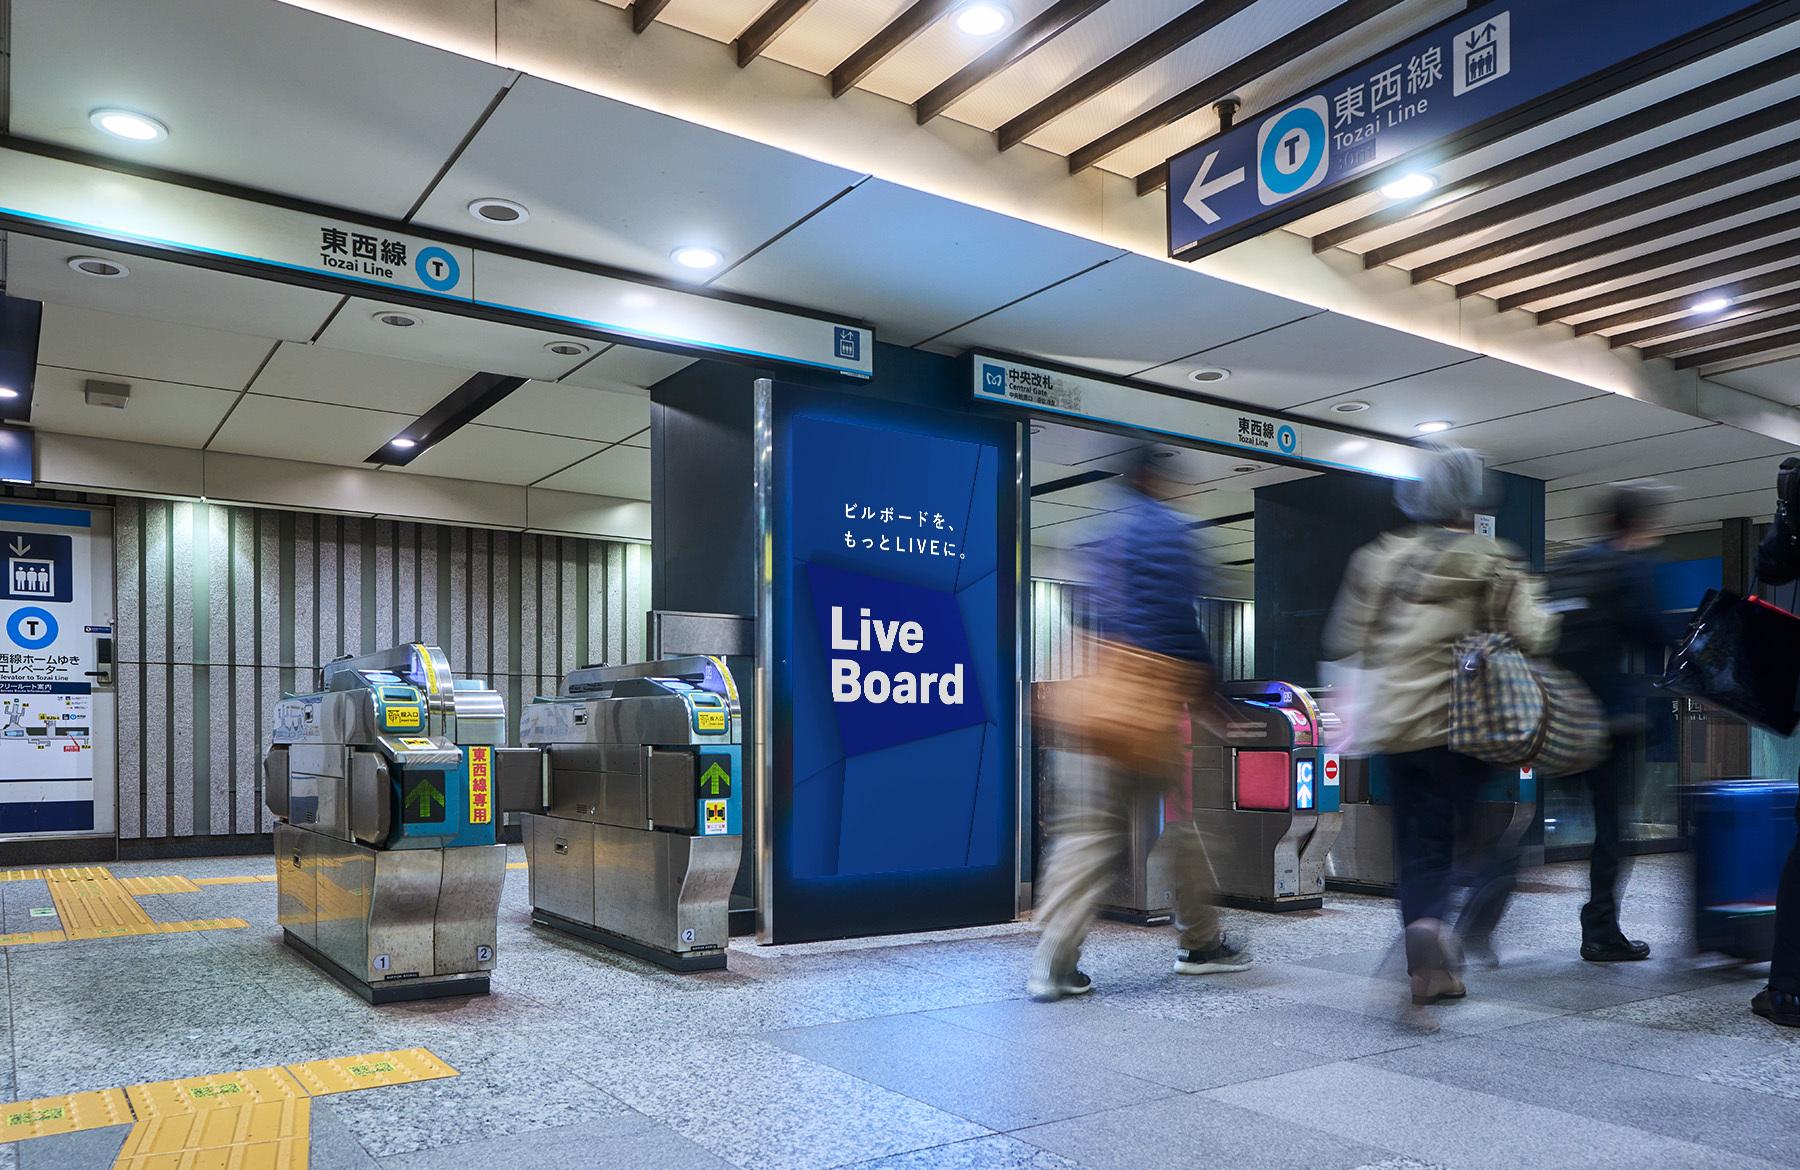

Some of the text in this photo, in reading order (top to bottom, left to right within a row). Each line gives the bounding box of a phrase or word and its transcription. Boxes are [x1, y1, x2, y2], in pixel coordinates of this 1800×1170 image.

[1333, 46, 1443, 129] 東西線
[1334, 99, 1428, 150] Tozai Line
[1284, 134, 1300, 166] T
[320, 227, 407, 267] 東西線
[320, 253, 393, 278] Tozai Line
[432, 261, 443, 277] T
[1008, 368, 1053, 390] 中央改札
[1009, 382, 1048, 397] Central Gate
[1238, 417, 1274, 439] 東西線
[1284, 434, 1290, 444] T
[1238, 434, 1269, 447] Tozai Line
[844, 530, 966, 560] もっとLIVEに。
[26, 620, 39, 636] T
[831, 605, 924, 654] Live
[0, 665, 68, 675] エレベーター
[831, 658, 964, 705] Board
[1297, 762, 1312, 783] IC
[473, 748, 487, 822] 東西線専用
[687, 930, 692, 940] 2
[380, 957, 385, 968] 1
[480, 947, 488, 959] 2
